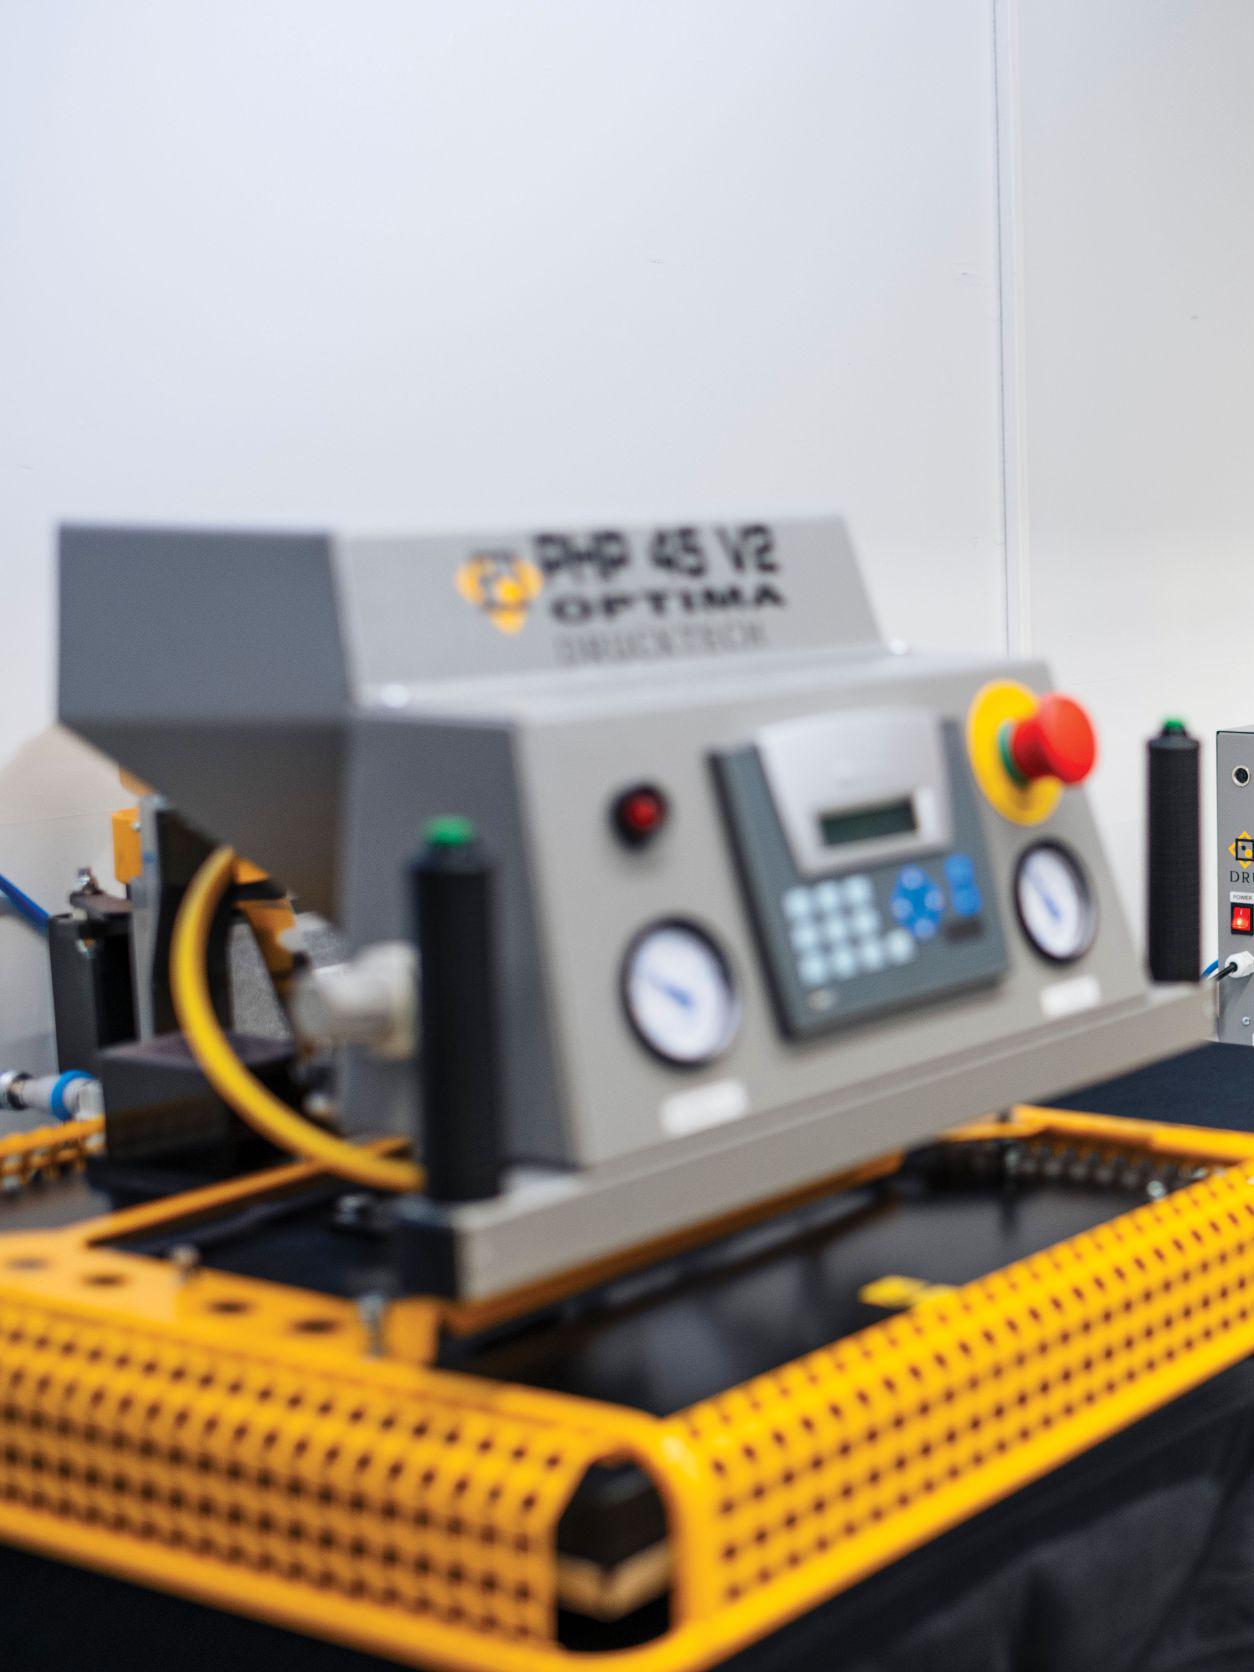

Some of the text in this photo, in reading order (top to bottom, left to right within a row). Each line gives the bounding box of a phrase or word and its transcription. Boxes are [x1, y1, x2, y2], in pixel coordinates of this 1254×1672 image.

[534, 523, 781, 577] PHP 45 V2
[551, 585, 787, 627] OPTIMA
